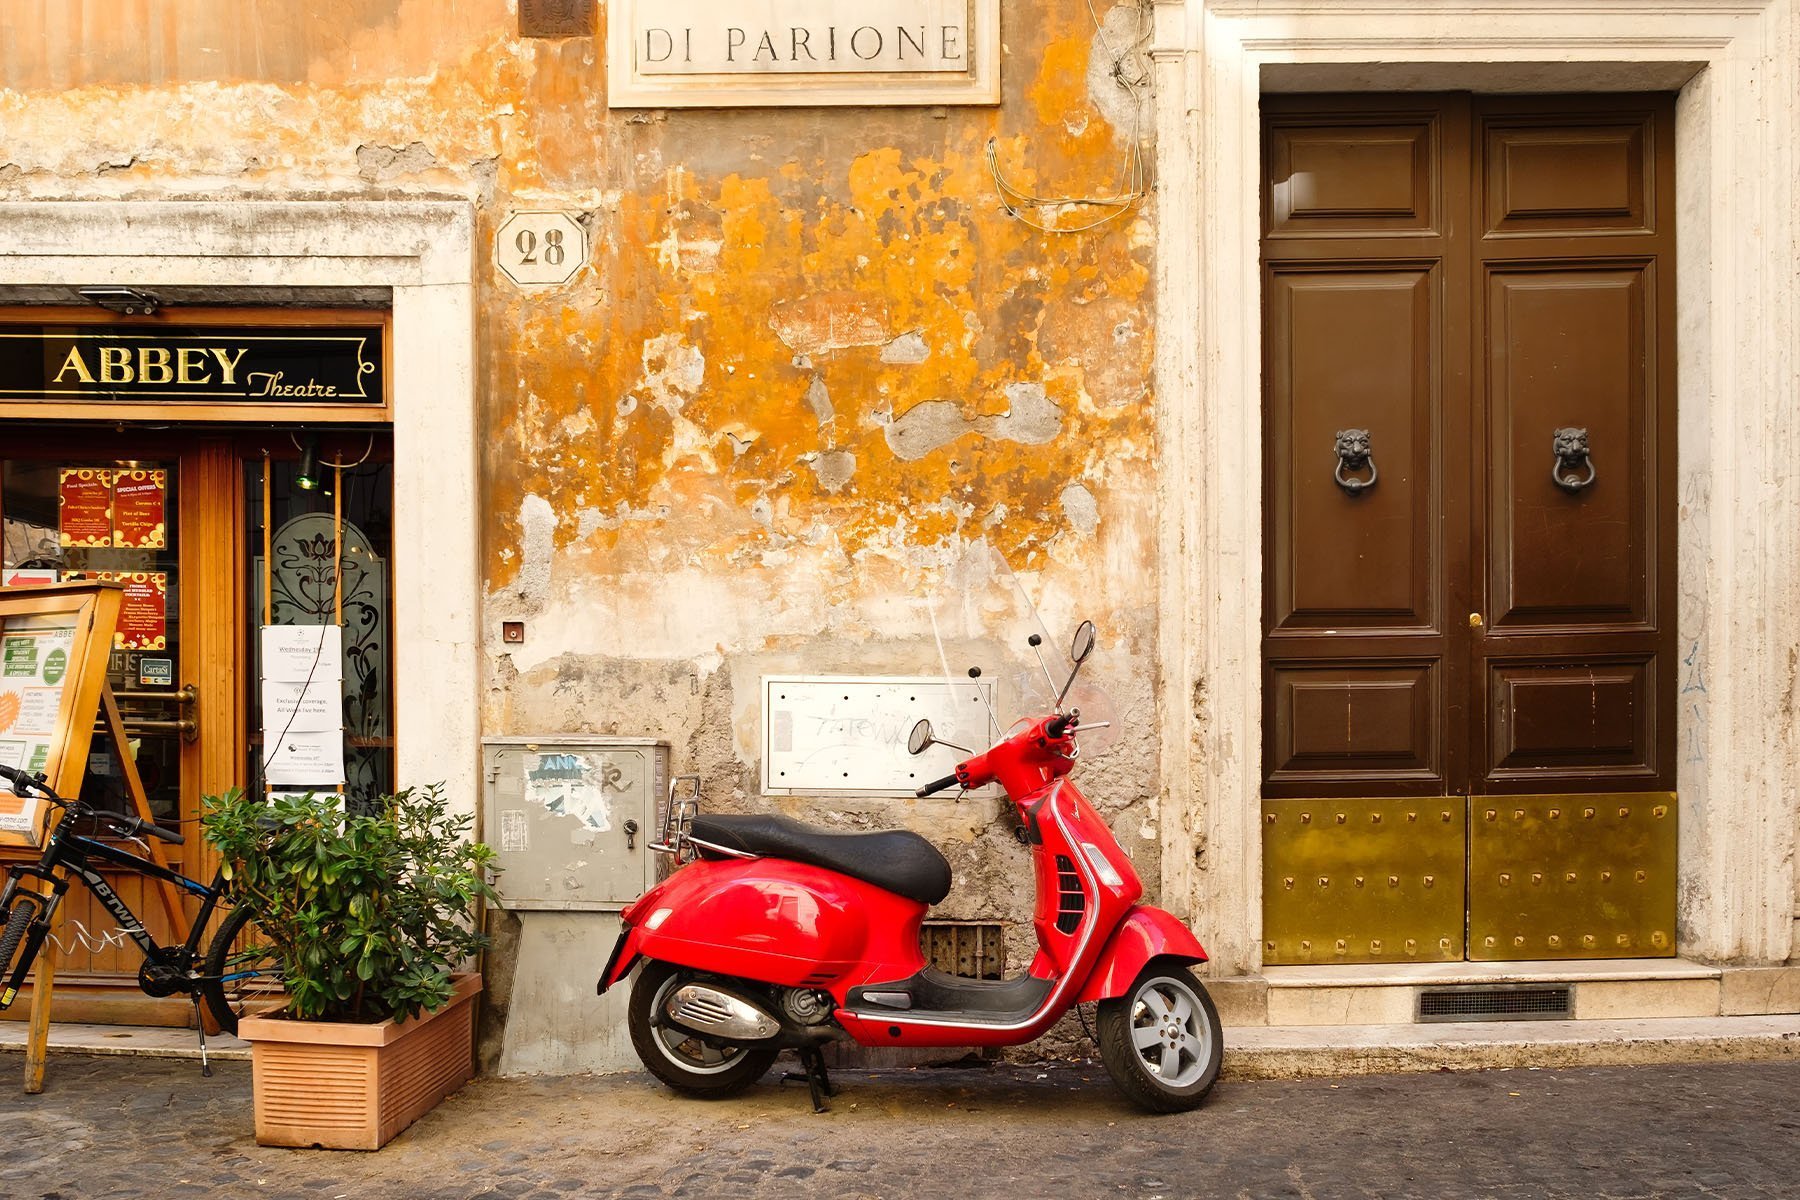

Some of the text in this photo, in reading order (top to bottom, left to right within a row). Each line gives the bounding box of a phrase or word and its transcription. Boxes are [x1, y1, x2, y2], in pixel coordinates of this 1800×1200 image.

[645, 25, 961, 62] DI PARIONE
[515, 229, 565, 266] 28
[52, 345, 338, 397] ABBEY Theatre
